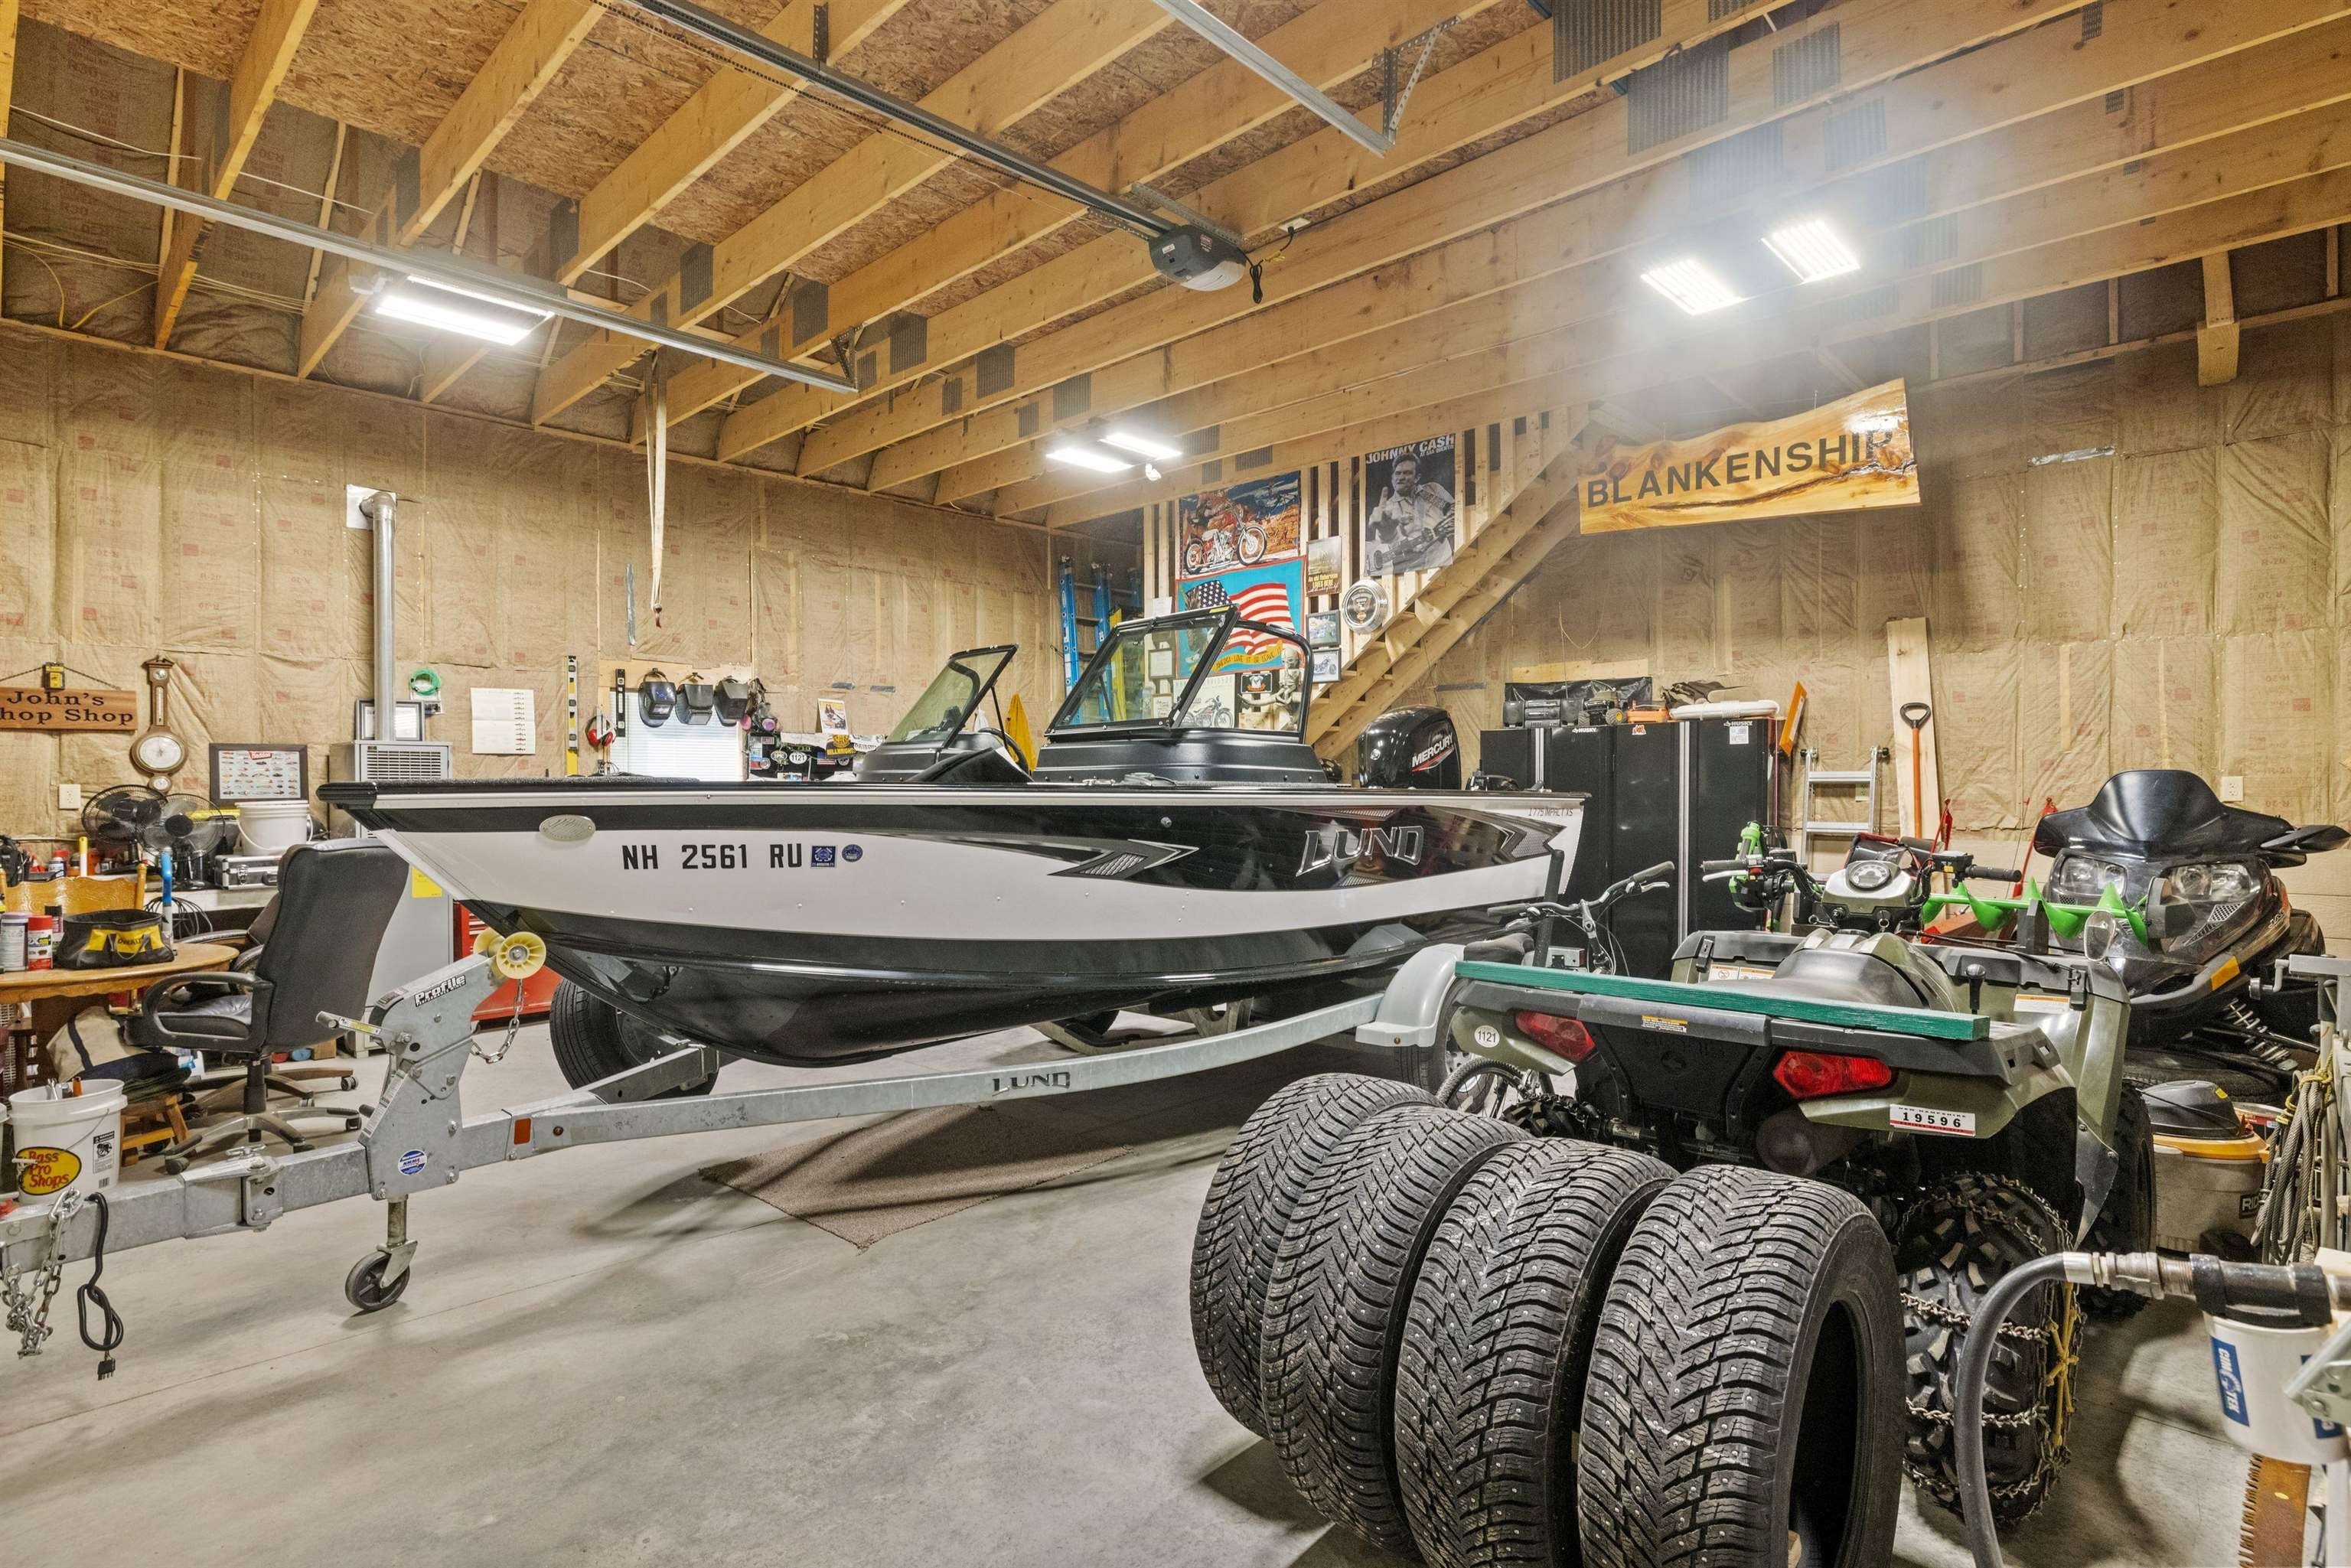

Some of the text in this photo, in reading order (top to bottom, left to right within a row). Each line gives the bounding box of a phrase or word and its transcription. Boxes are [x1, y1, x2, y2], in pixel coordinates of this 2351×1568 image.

[1366, 435, 1454, 464] JOHNNY CASH
[1587, 430, 1893, 507] BLANKENSHIP
[7, 691, 105, 705] John's
[0, 707, 133, 725] hop Shop
[791, 753, 805, 761] 1121
[1412, 732, 1453, 768] MERCURY
[1528, 807, 1573, 817] 1775 IMPACT XS
[621, 843, 802, 870] NH 2561 RU
[1296, 826, 1424, 877] LUND
[415, 976, 466, 1004] Profile
[1477, 1028, 1497, 1044] 1121
[992, 1072, 1071, 1097] LUND
[1903, 1112, 1961, 1128] 19596
[28, 1151, 60, 1163] Bass
[28, 1164, 51, 1175] Pro
[29, 1174, 69, 1189] Shops
